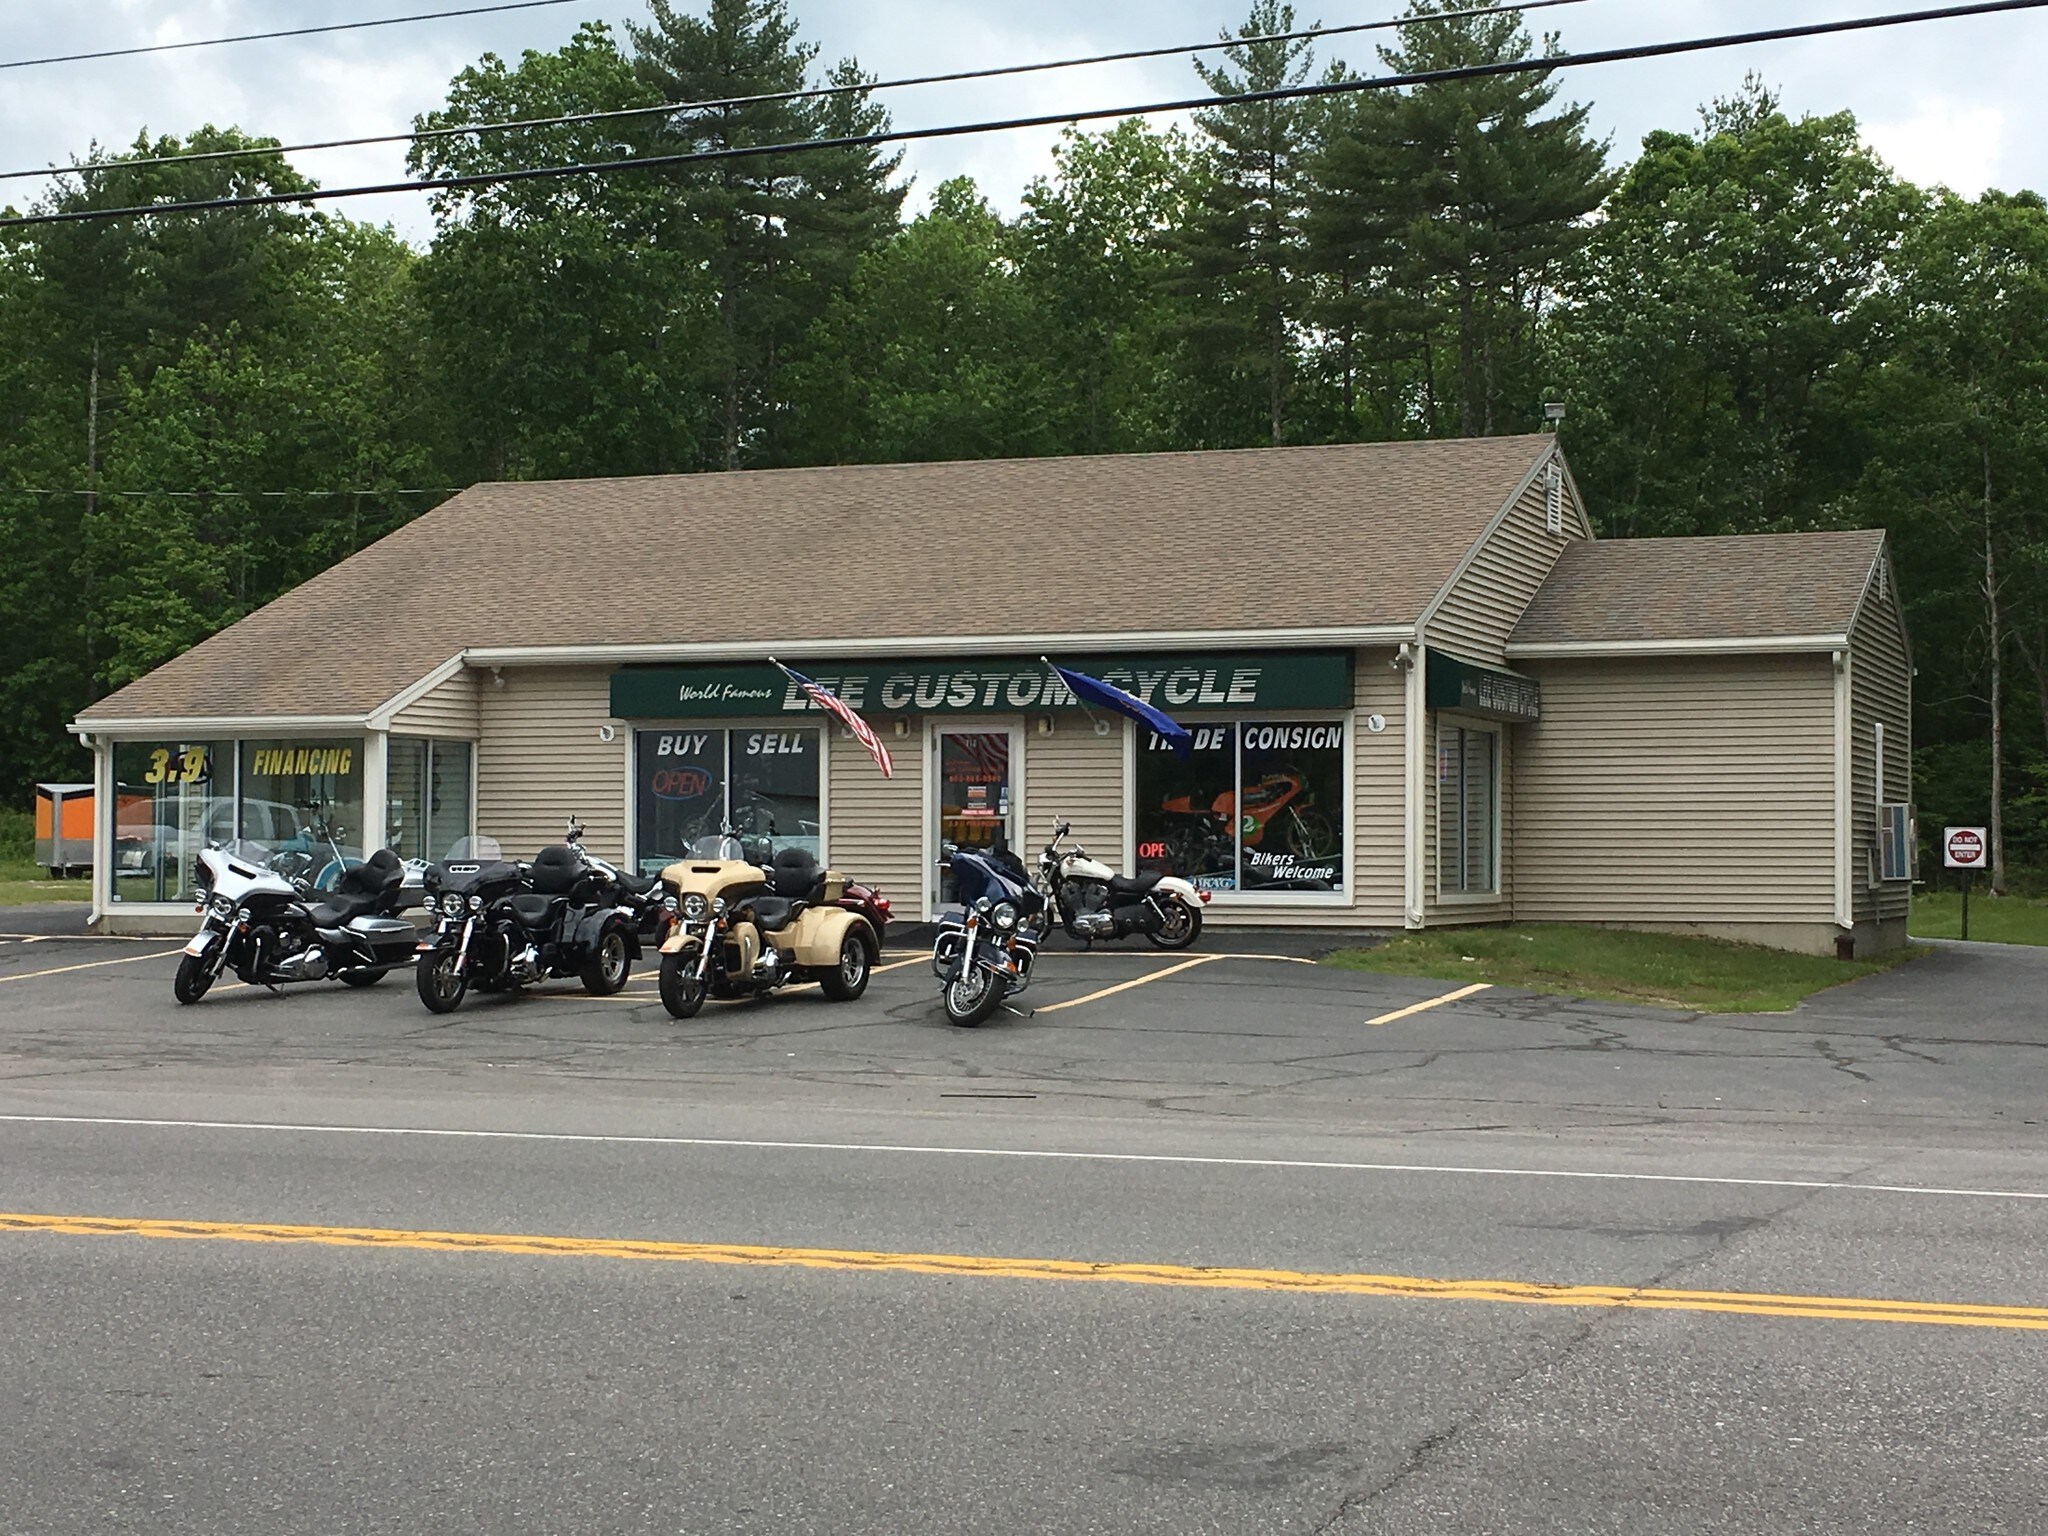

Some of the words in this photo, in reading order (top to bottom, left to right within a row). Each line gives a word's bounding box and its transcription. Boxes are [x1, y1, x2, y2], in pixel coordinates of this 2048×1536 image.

[680, 683, 721, 701] World
[721, 684, 772, 701] Famous
[657, 735, 708, 756] BUY
[746, 733, 804, 755] SELL
[1244, 727, 1342, 750] CONSIGN
[145, 746, 206, 784] 3.9
[252, 749, 353, 776] FINANCING
[652, 769, 707, 796] OPEN
[1243, 815, 1255, 832] 2
[1140, 843, 1175, 858] OPEN
[1250, 852, 1295, 866] Bikers
[1272, 866, 1334, 879] Welcome
